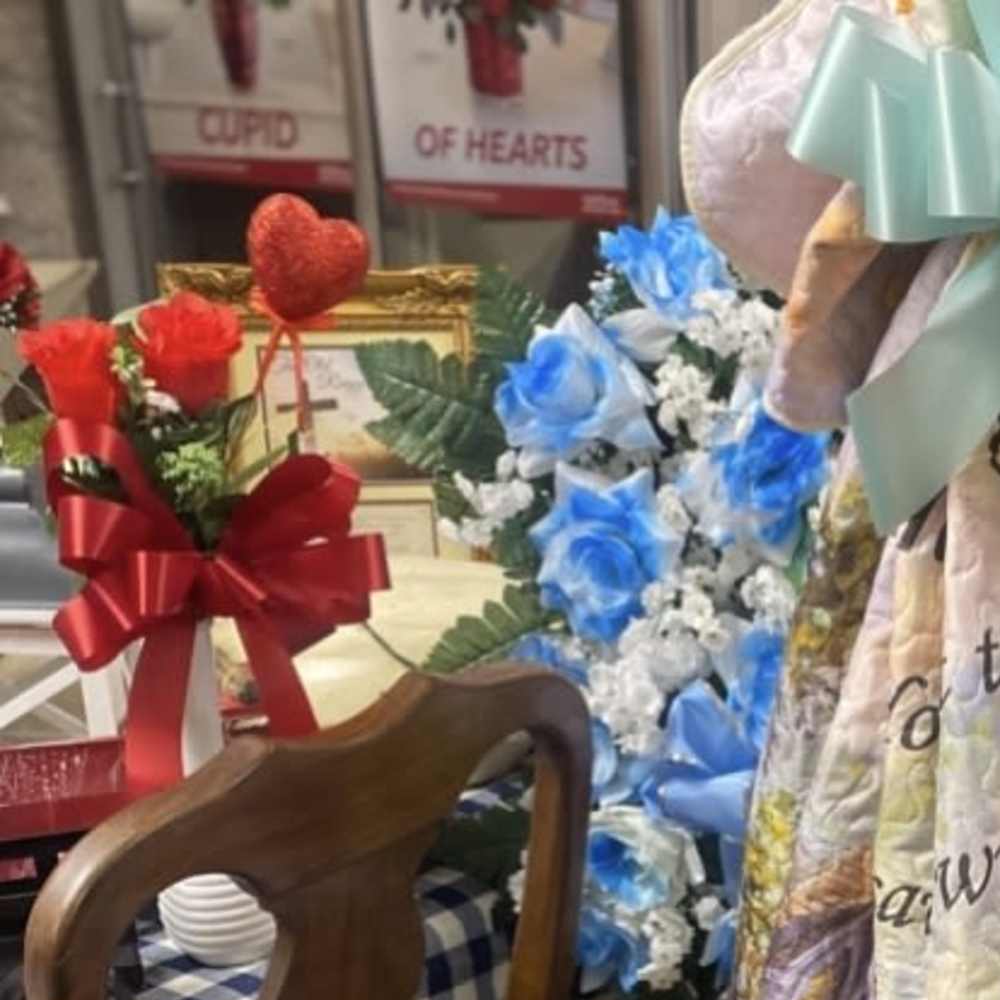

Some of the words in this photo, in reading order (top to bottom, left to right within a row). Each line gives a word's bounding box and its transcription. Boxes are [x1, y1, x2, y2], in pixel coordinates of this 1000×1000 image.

[197, 106, 296, 149] CUPID
[414, 124, 457, 158] OF
[464, 128, 588, 172] HEARTS
